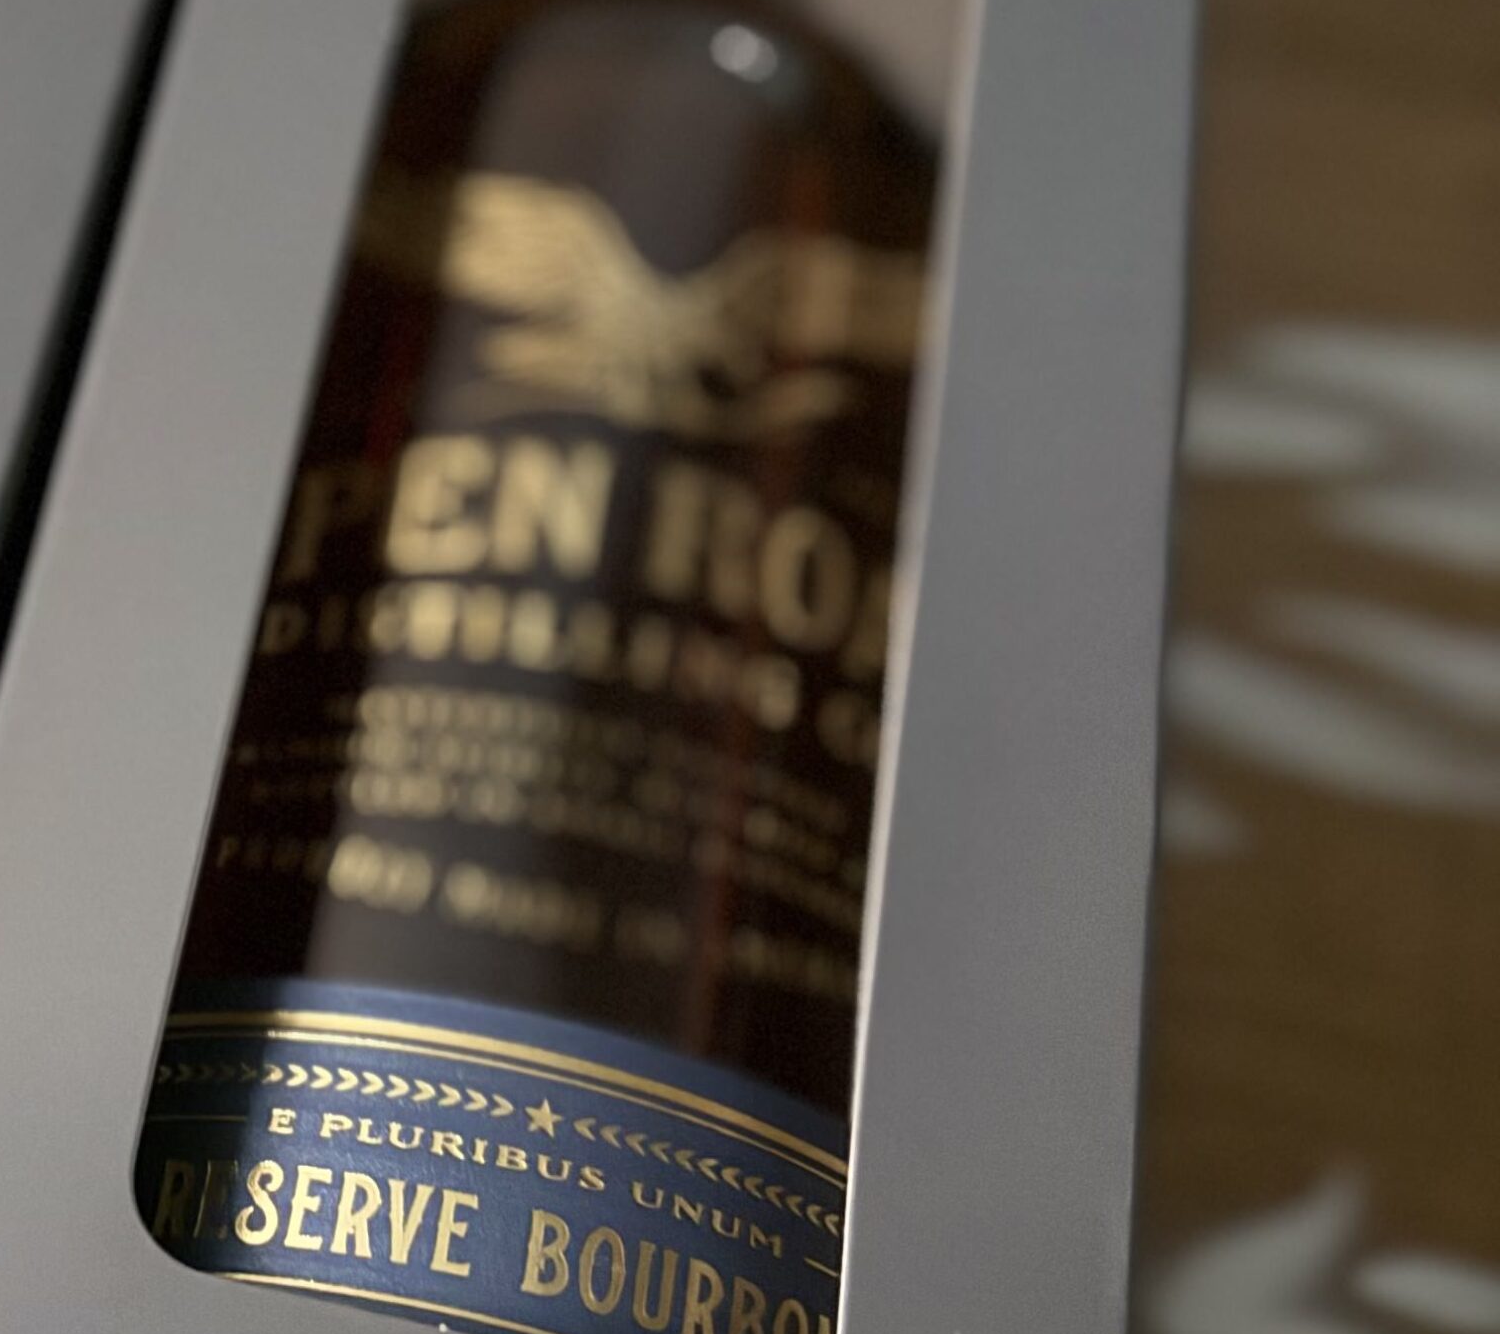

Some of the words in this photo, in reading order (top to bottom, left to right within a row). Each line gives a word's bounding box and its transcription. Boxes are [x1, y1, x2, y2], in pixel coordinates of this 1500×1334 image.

[268, 1106, 298, 1136] E
[319, 1112, 606, 1192] PLURIBUS
[631, 1180, 786, 1260] UNUM
